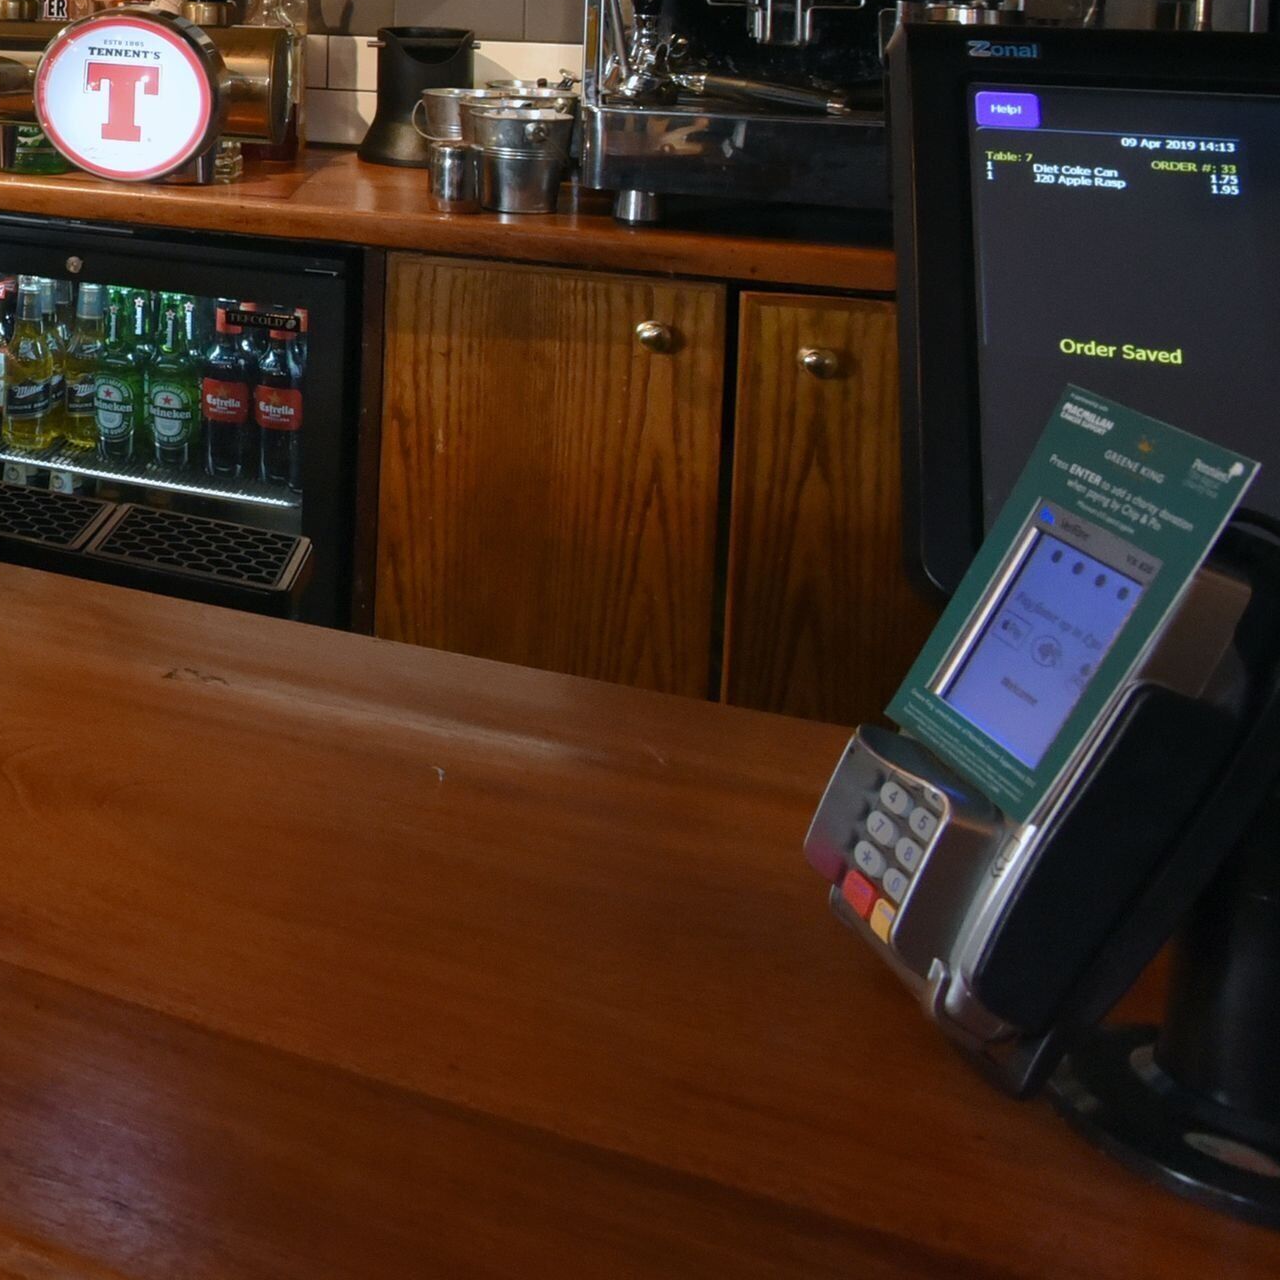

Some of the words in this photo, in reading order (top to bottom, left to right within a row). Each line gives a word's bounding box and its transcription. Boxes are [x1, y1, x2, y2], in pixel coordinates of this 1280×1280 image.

[87, 46, 162, 61] TENNENT'S
[968, 40, 1038, 59] Zonal
[85, 61, 161, 143] T
[991, 104, 1022, 116] Help!
[1121, 137, 1138, 148] 09
[1140, 138, 1162, 150] Apr
[1165, 139, 1196, 151] 2019
[1199, 141, 1236, 153] 14:13
[986, 151, 1023, 162] Table:
[1025, 153, 1033, 163] 7
[986, 161, 993, 171] 1
[1033, 163, 1059, 175] Diet
[1061, 165, 1091, 176] Coke
[1093, 167, 1119, 178] Can
[1210, 174, 1239, 185] 1.75
[1151, 161, 1198, 173] ORDER
[1221, 165, 1237, 174] 33
[986, 171, 993, 181] 1
[1057, 175, 1091, 188] Apple
[1093, 177, 1127, 190] Rasp
[1211, 184, 1240, 195] 1.95
[1059, 338, 1118, 358] Order
[1121, 342, 1183, 366] Saved
[206, 394, 241, 409] Estrella
[258, 401, 294, 417] Estrella
[1061, 401, 1115, 432] MACMILLAN
[1049, 453, 1070, 471] Press
[1068, 463, 1102, 487] ENTER
[1103, 449, 1139, 473] GREENE
[1139, 465, 1166, 485] KING
[889, 790, 899, 804] 4
[872, 819, 885, 834] 7
[916, 815, 929, 831] 5
[903, 846, 914, 862] 8
